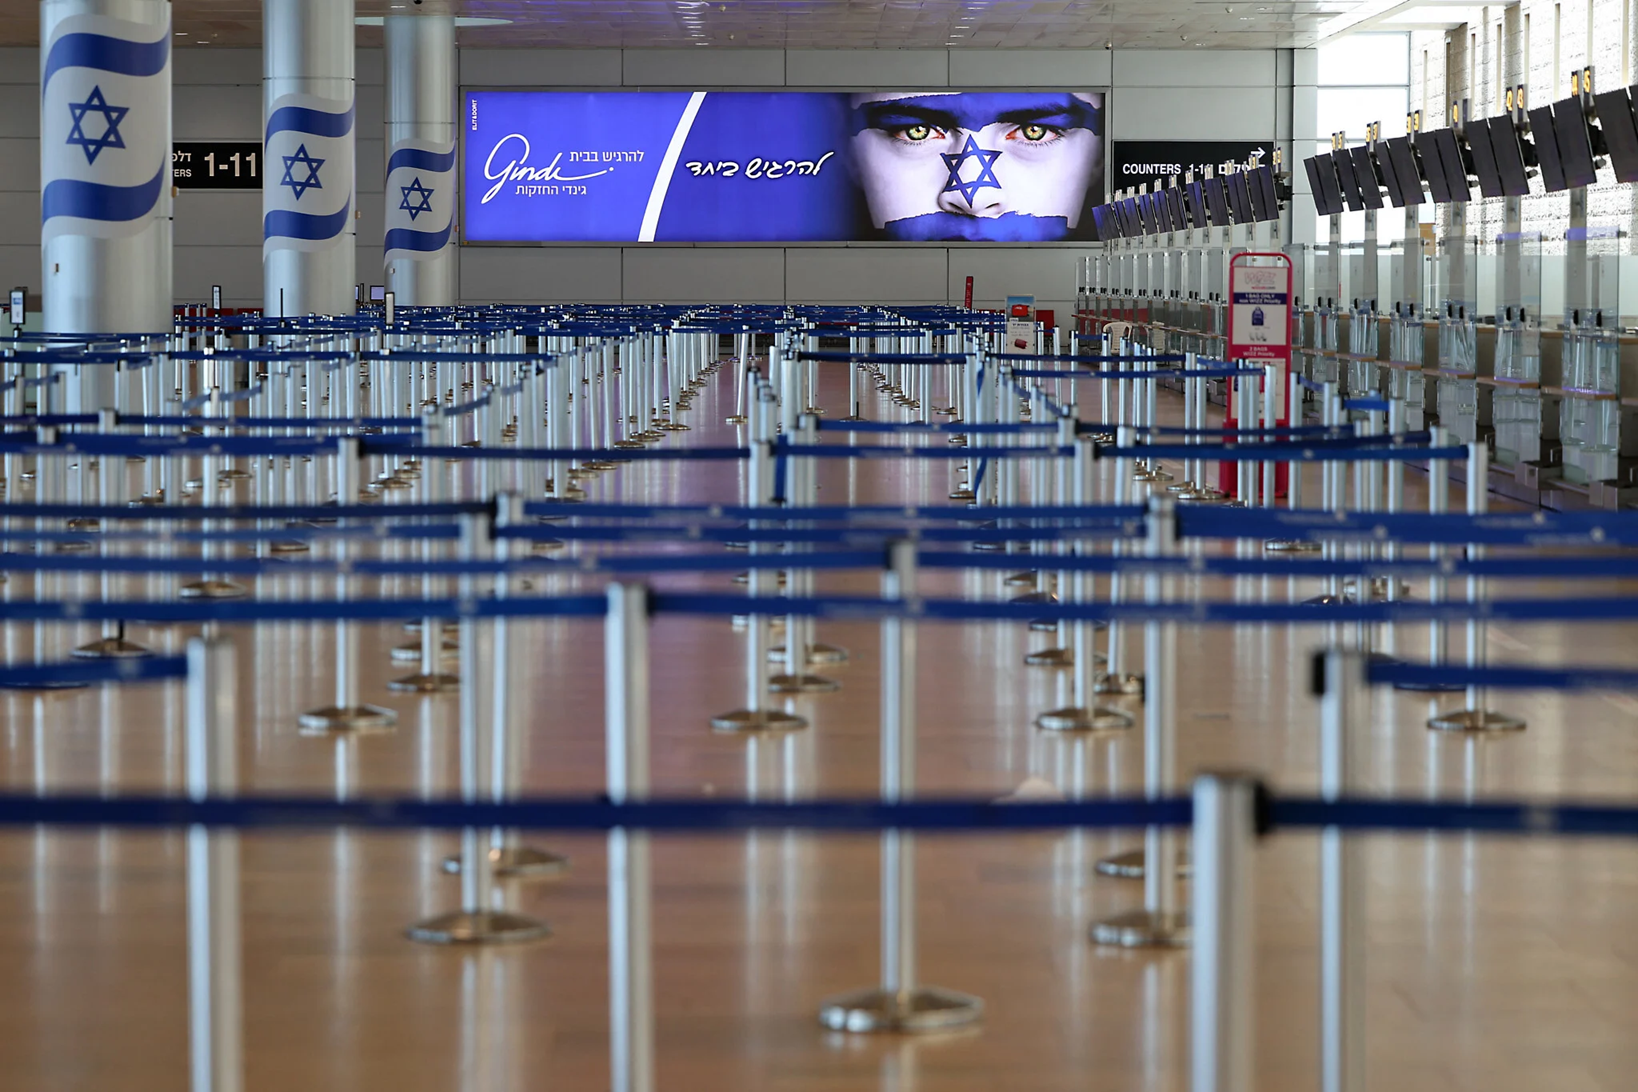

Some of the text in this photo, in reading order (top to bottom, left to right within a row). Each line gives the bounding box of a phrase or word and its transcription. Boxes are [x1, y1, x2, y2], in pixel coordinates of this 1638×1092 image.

[569, 150, 645, 162] להרגיש בבית
[204, 152, 256, 177] 1-11
[685, 150, 834, 179] להרגיש ביחד
[1122, 163, 1181, 175] COUNTERS
[172, 169, 192, 177] ERS
[515, 185, 587, 198] גינדי החזקות
